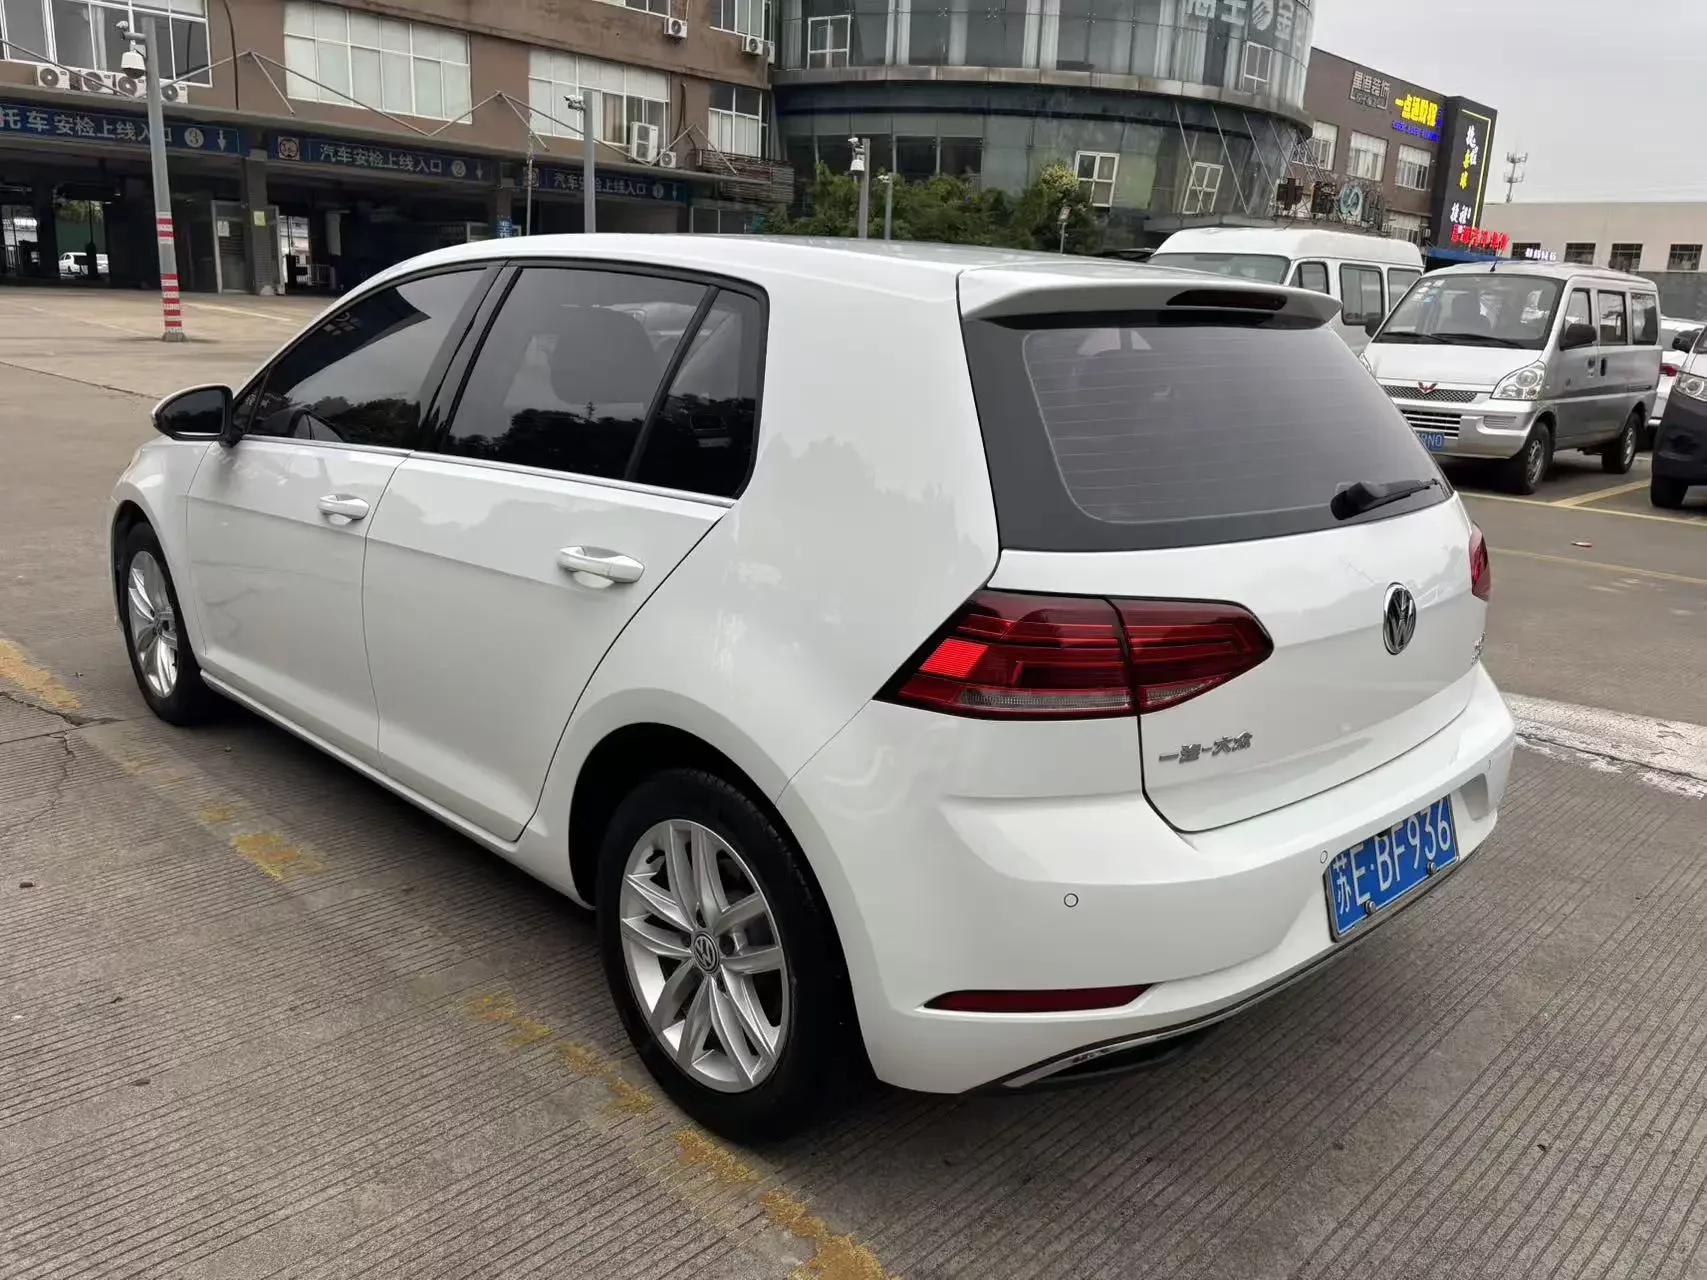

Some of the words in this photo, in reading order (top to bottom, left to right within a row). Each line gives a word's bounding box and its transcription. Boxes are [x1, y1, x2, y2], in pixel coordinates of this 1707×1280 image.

[320, 143, 442, 174] 汽车安检上线入口
